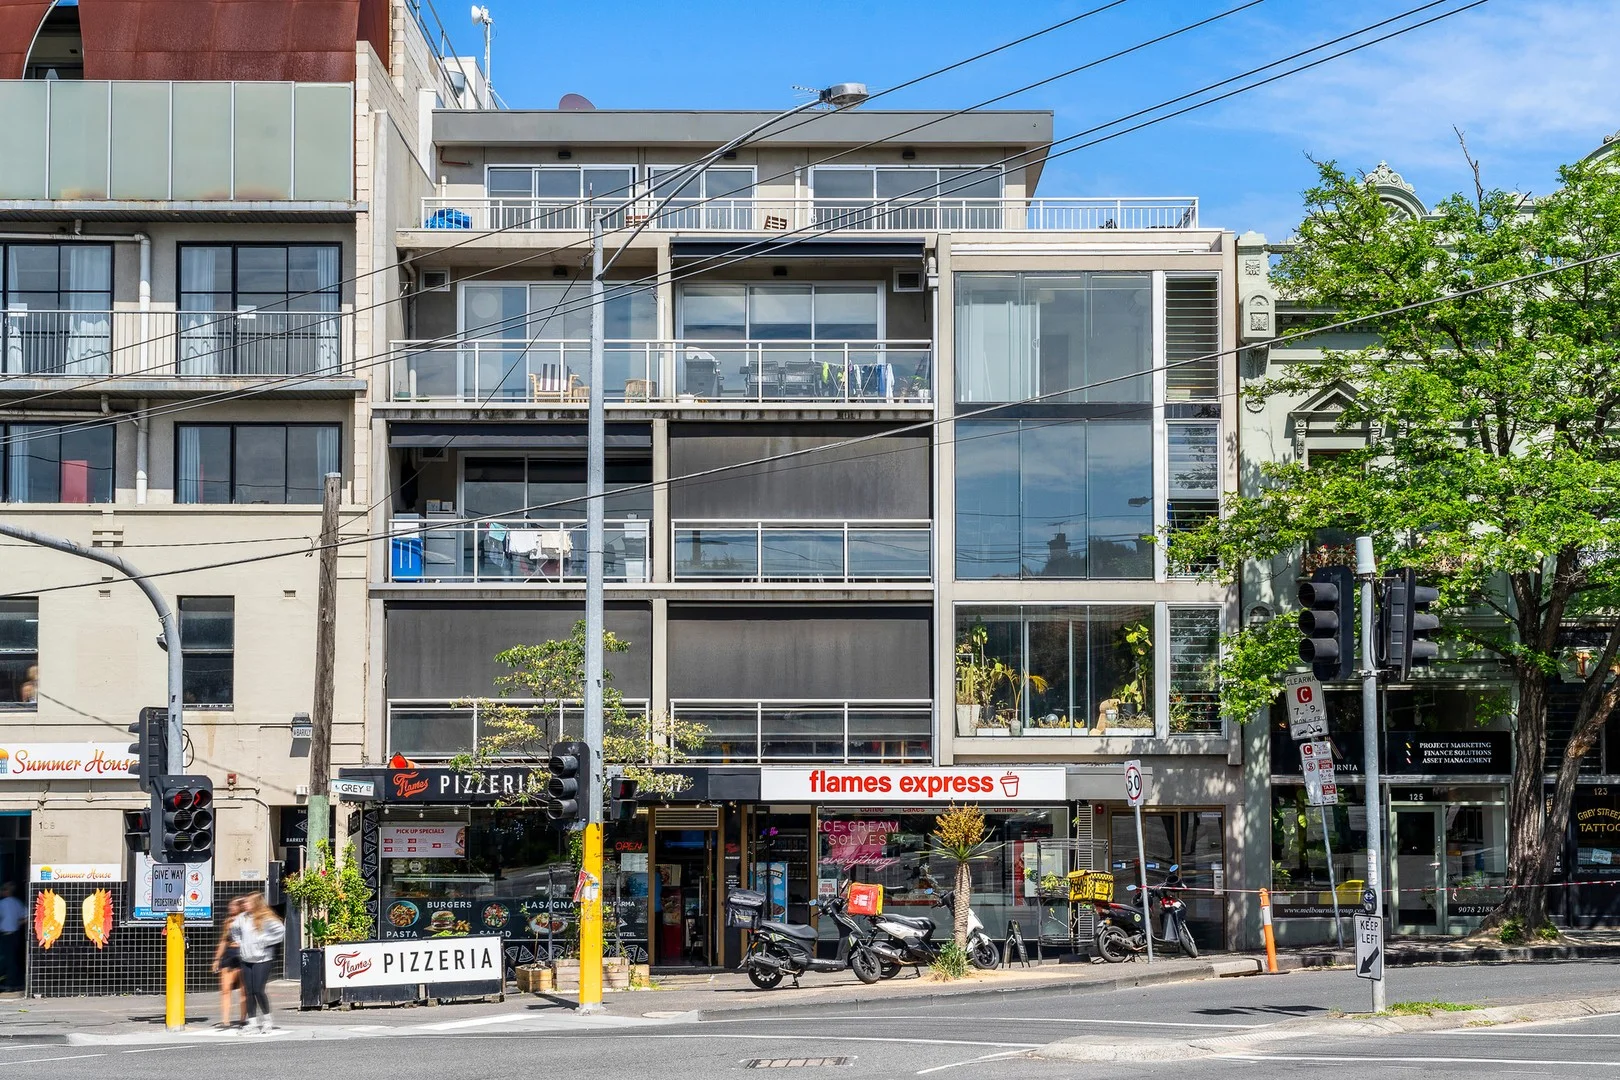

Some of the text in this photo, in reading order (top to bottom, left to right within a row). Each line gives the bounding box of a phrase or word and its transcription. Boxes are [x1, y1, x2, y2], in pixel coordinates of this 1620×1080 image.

[1287, 675, 1317, 686] CLEARWA
[1300, 688, 1310, 701] C
[296, 728, 312, 737] BARKLY
[1304, 745, 1312, 755] C
[12, 749, 81, 774] Summer
[341, 783, 364, 793] GREY
[393, 771, 430, 798] Flames
[809, 770, 995, 798] flames express
[1127, 774, 1140, 792] 50
[1409, 793, 1424, 801] 125
[1593, 787, 1608, 796] 123
[1577, 808, 1596, 821] GREY
[817, 820, 900, 833] ICE CREAM
[828, 834, 888, 846] SOLVES
[615, 841, 643, 851] OPEN
[818, 851, 901, 873] everything
[53, 868, 112, 880] Summer House
[154, 869, 184, 880] GIVE WAY
[164, 882, 173, 893] TO
[154, 898, 182, 907] PEDESTRIANS
[426, 901, 473, 909] BURGERS
[525, 901, 576, 909] LASAGNA
[1360, 920, 1379, 931] KEEP
[386, 930, 418, 938] PASTA
[1361, 933, 1378, 945] LEFT
[334, 947, 494, 980] Flames PIZZERIA
